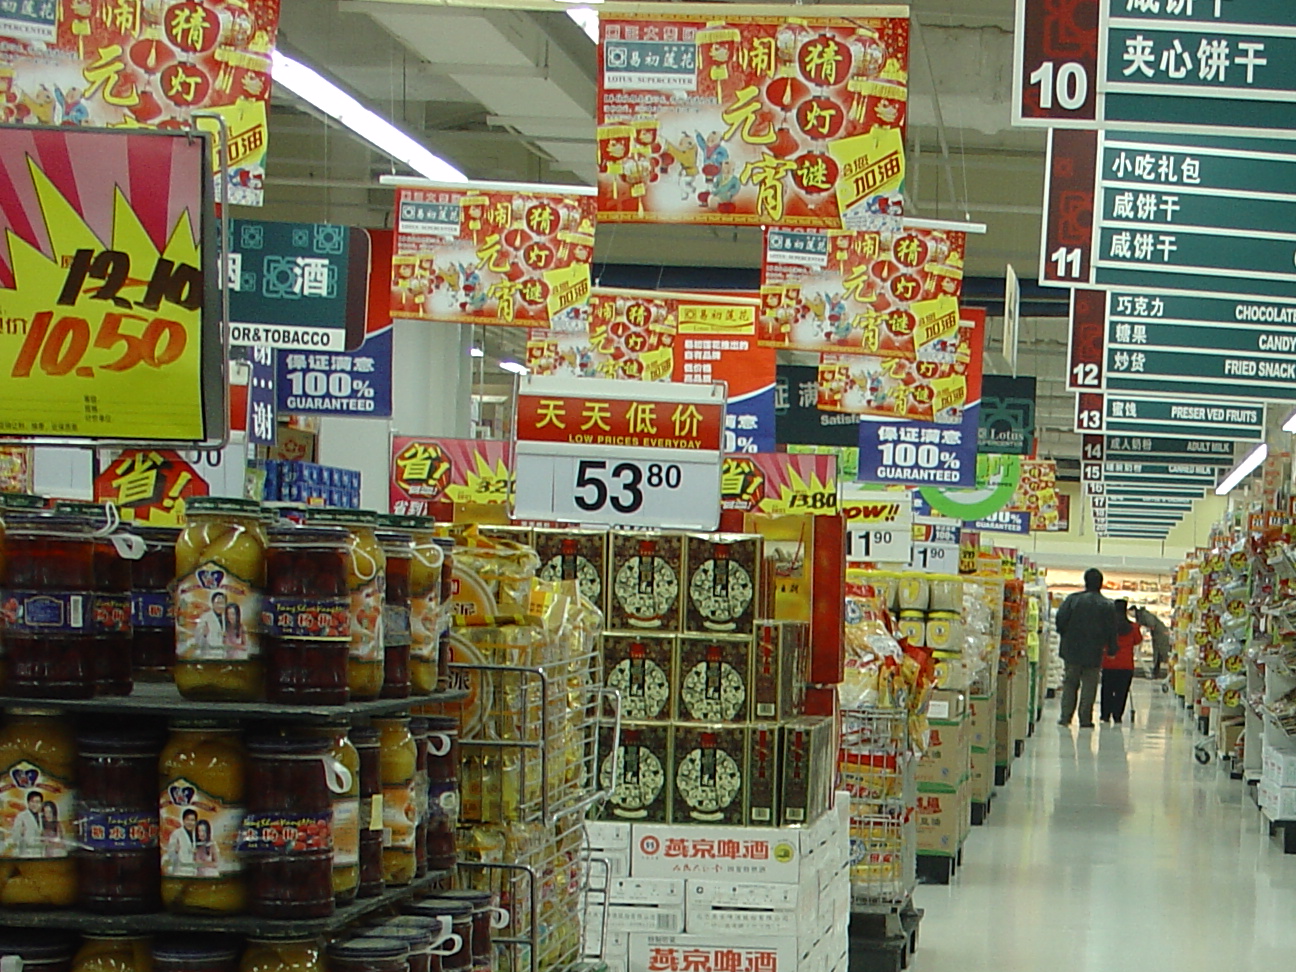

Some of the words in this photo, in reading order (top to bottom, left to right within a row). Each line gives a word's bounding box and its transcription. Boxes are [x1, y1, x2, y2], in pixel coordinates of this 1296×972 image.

[629, 46, 694, 69] 易初莲花
[1123, 35, 1267, 84] 夹心饼干
[608, 76, 632, 84] LOTUS
[638, 77, 693, 85] SUPERCENTER
[1030, 62, 1088, 110] 10
[854, 158, 899, 197] 加油
[1112, 151, 1201, 184] 小吃礼包
[1113, 192, 1180, 223] 咸饼干
[1110, 233, 1177, 262] 咸饼干
[1051, 248, 1082, 279] 11
[1116, 296, 1164, 318] 巧克力
[1115, 324, 1147, 346] 糖果
[1258, 334, 1296, 353] CANDY
[286, 354, 374, 372] 保证满意
[1114, 353, 1146, 374] 炒货
[1225, 359, 1254, 377] FRIED
[1256, 360, 1295, 379] SNACK
[286, 372, 374, 397] 100%
[1073, 364, 1098, 387] 12
[287, 397, 374, 411] GUARANTEED
[536, 400, 703, 437] 天天低价
[1080, 410, 1100, 427] 13
[1226, 409, 1257, 422] FRUITS
[569, 434, 593, 443] LOW
[598, 436, 638, 446] PRICES
[643, 437, 701, 449] EVERYDAY
[878, 426, 961, 444] 保证满意
[990, 430, 1024, 441] Lotus
[878, 444, 960, 468] 100%
[1085, 443, 1101, 458] 14
[877, 467, 960, 482] GUARANTEED
[1085, 466, 1100, 478] 15
[575, 460, 643, 513] 53
[647, 464, 682, 489] 80
[663, 839, 769, 859] 燕京啤酒
